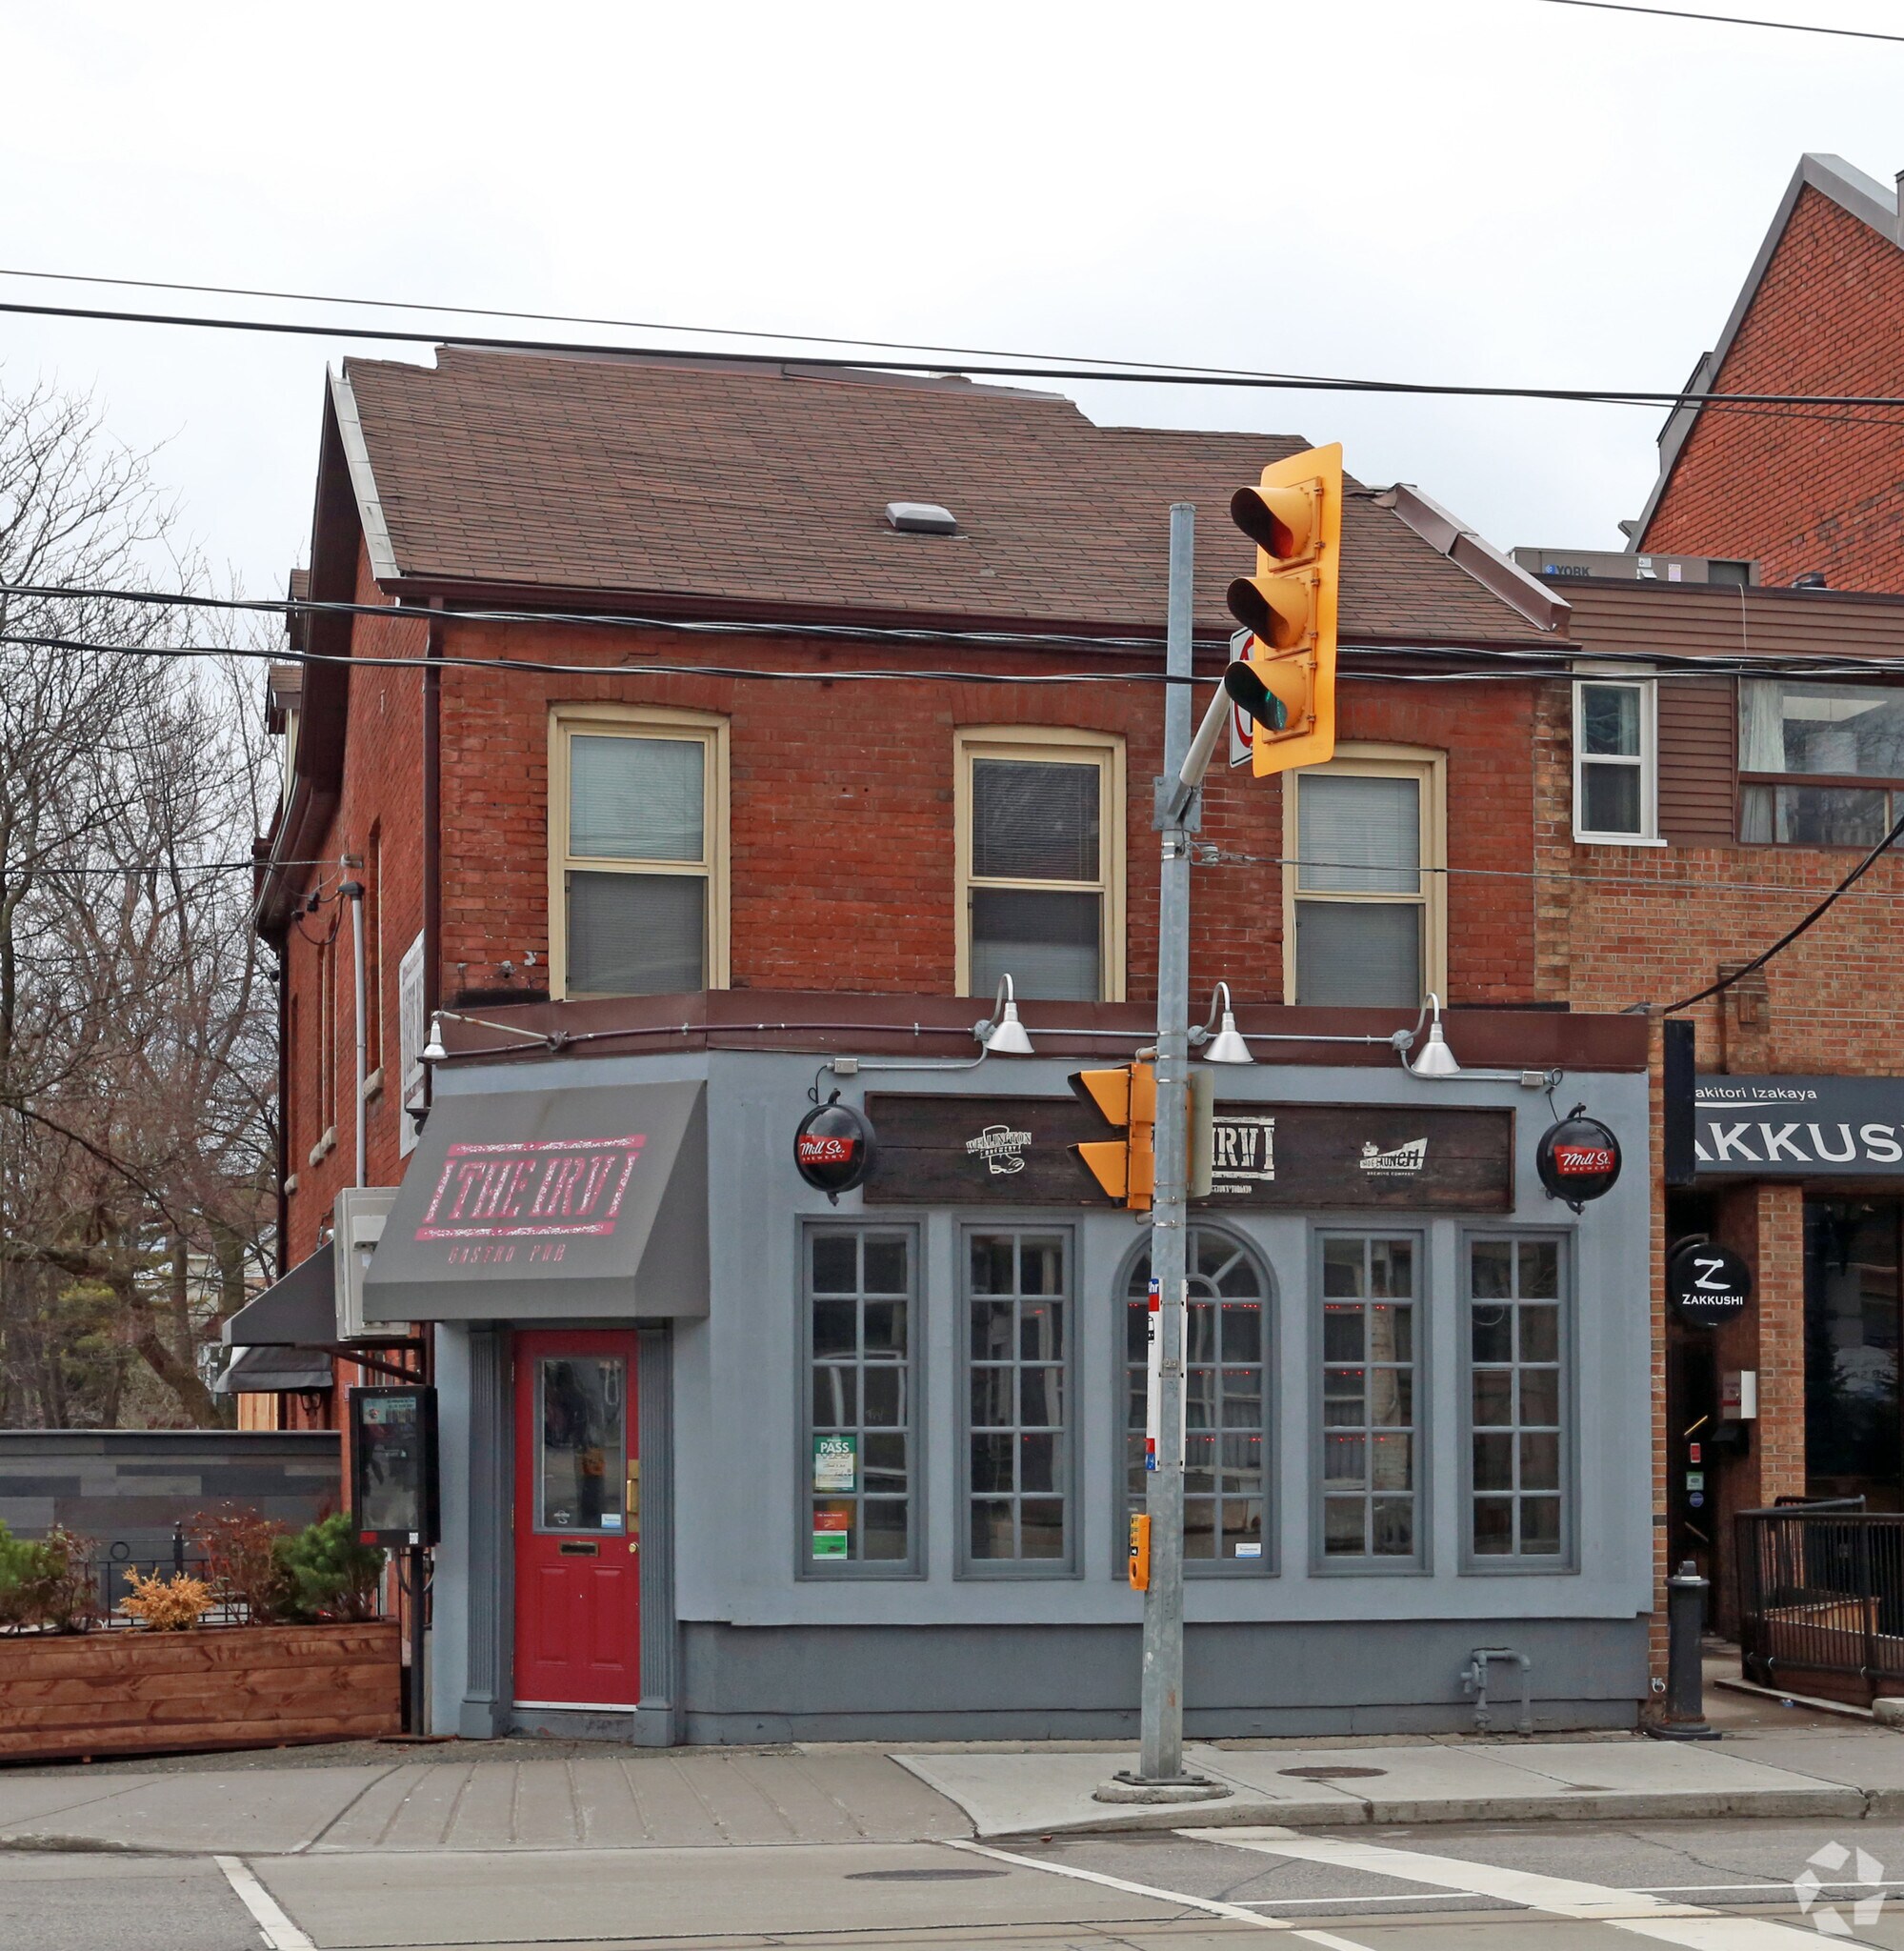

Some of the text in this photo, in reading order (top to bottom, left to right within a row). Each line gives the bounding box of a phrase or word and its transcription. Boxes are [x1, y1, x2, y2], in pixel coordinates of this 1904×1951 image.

[1556, 564, 1592, 576] YORK
[1695, 1087, 1817, 1101] akitori Izakaya
[800, 1141, 825, 1156] Mill
[966, 1132, 1032, 1154] WELLINGTON
[1694, 1122, 1904, 1162] KKUS
[1560, 1152, 1595, 1166] Mill
[449, 1155, 616, 1220] THE IRV
[448, 1243, 566, 1264] GASTRO PUB
[1682, 1294, 1744, 1306] ZAKKUSHI
[820, 1441, 850, 1454] PASS
